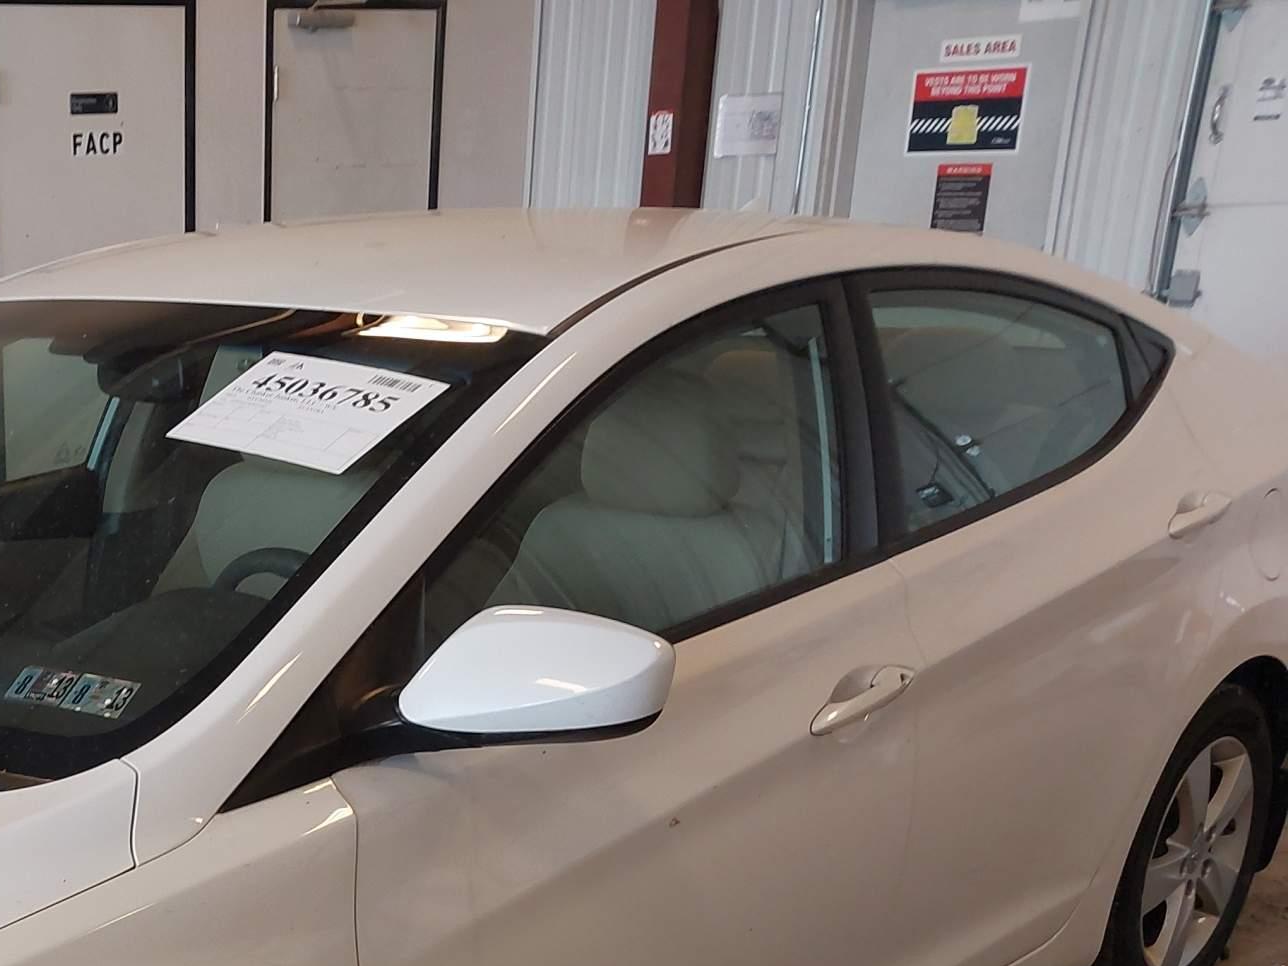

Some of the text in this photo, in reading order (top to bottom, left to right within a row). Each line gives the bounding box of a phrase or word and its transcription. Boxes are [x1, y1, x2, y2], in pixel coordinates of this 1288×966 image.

[943, 39, 1017, 57] SALES AREA
[72, 131, 123, 156] FACP
[252, 373, 401, 413] 45036785
